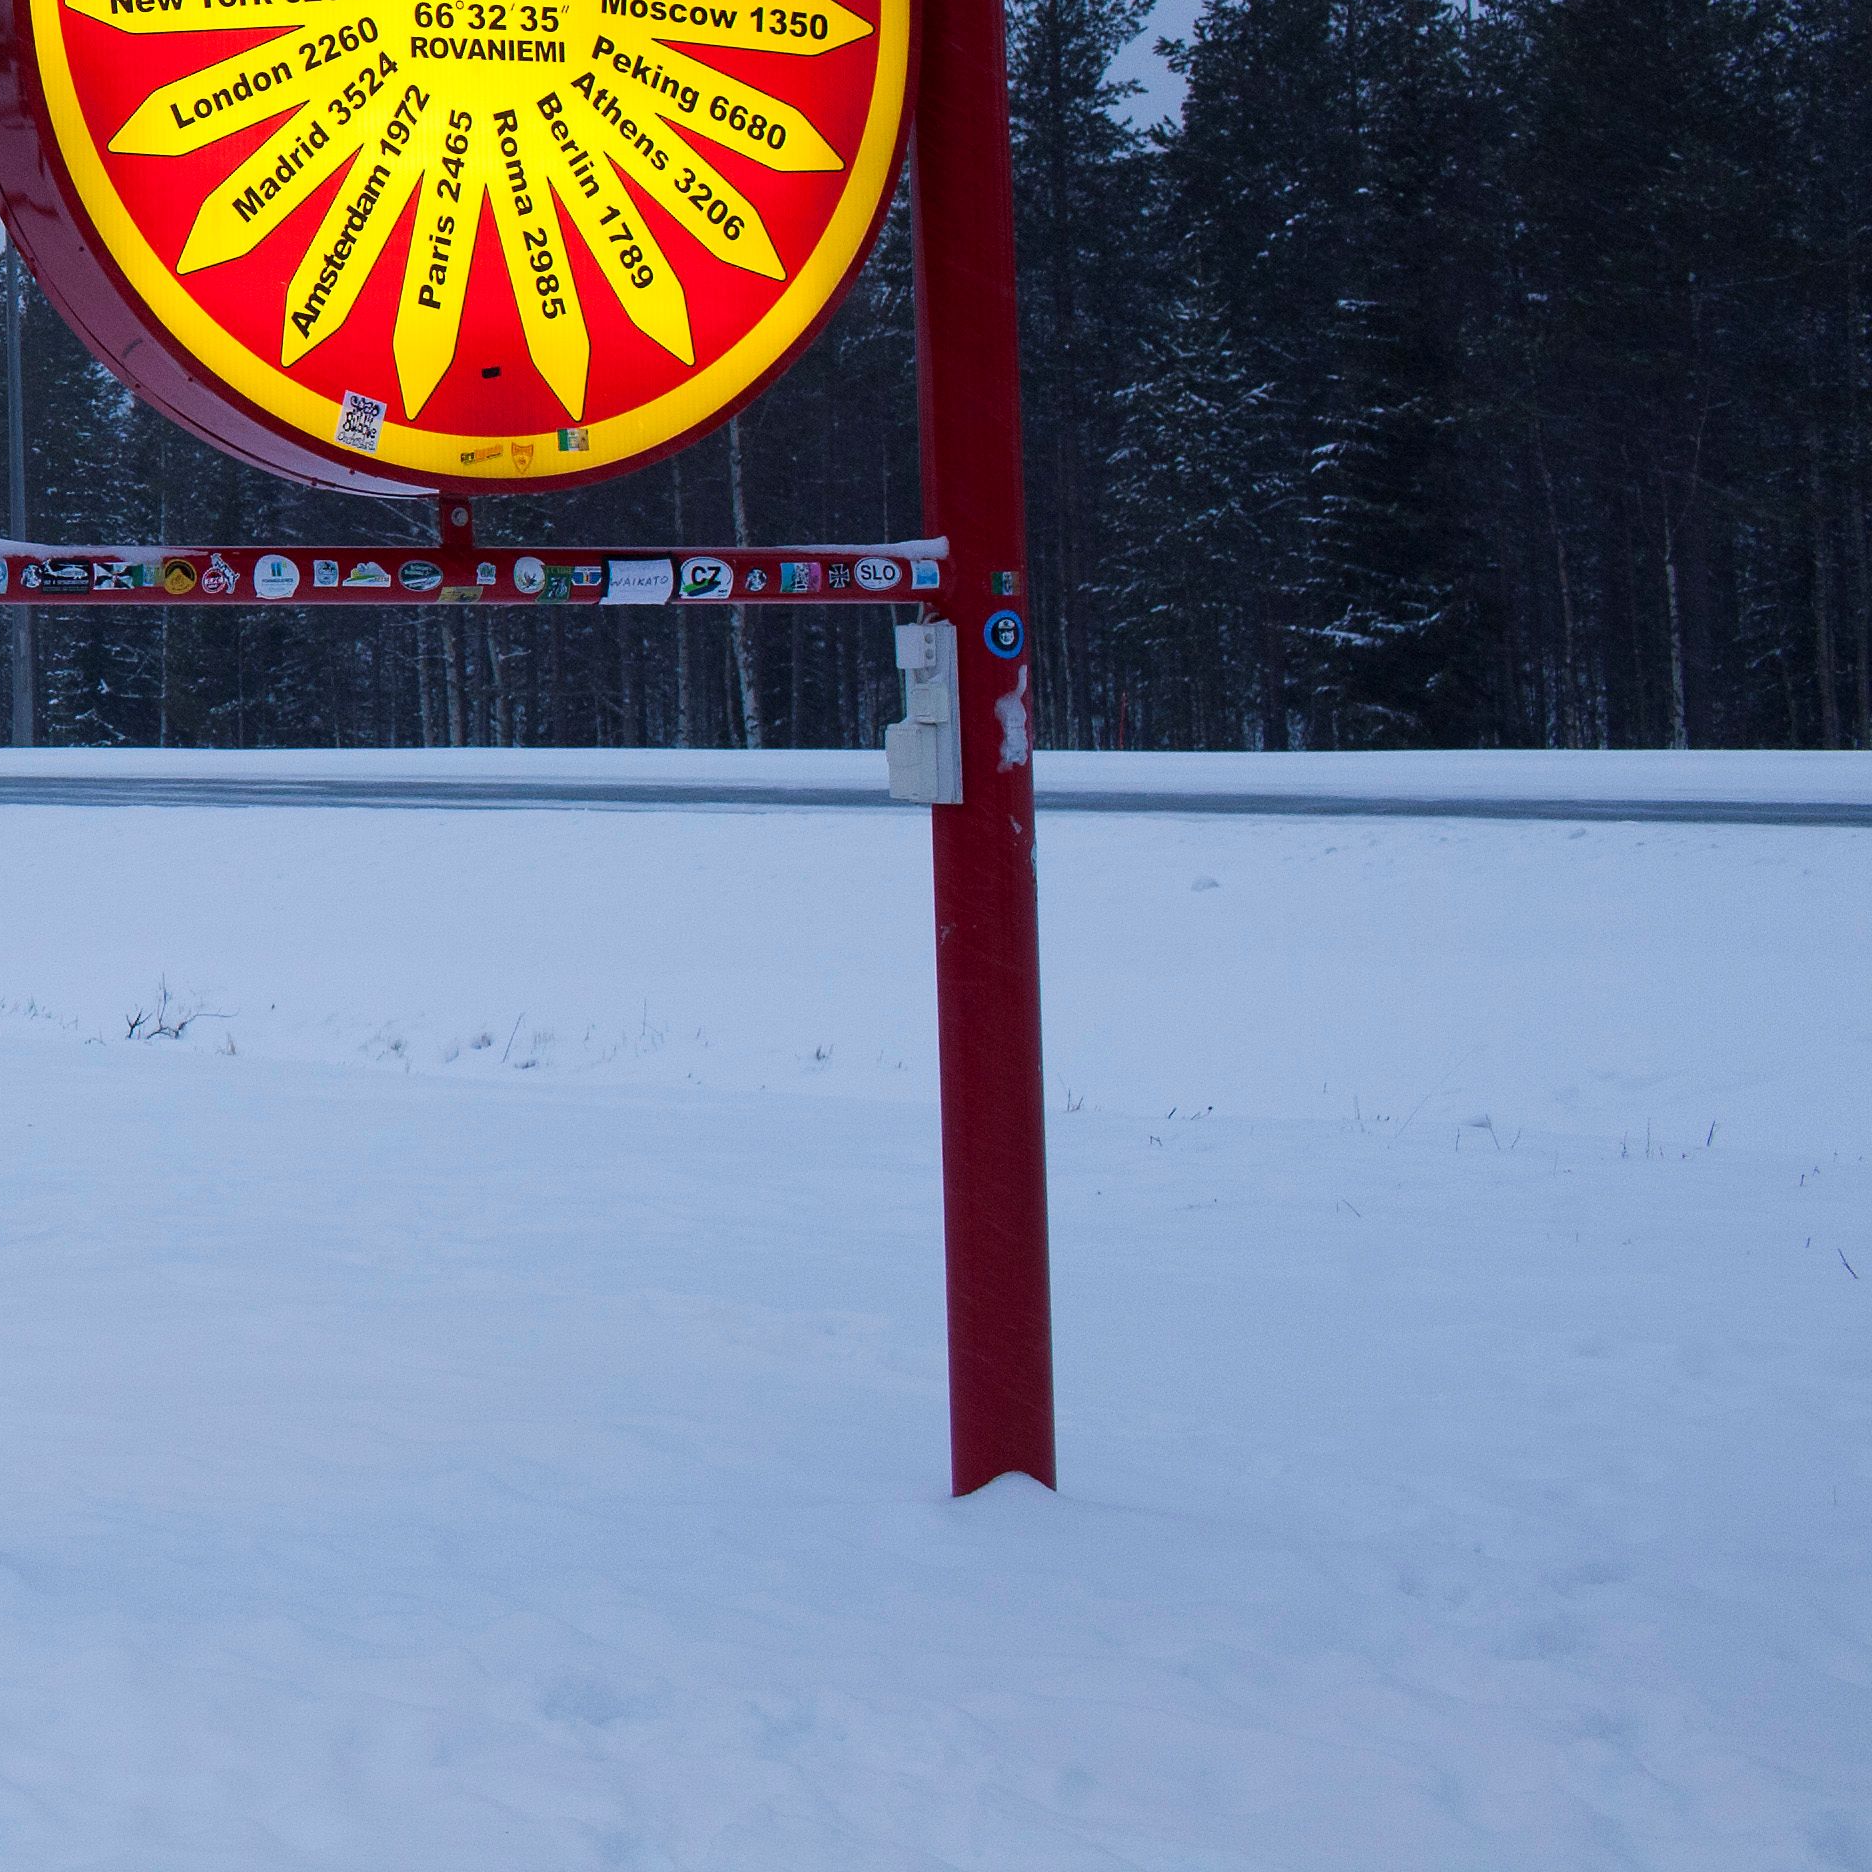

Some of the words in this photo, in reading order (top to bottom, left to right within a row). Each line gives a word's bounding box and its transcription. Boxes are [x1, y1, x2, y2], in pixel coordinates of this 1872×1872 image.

[171, 63, 292, 128] London
[299, 17, 378, 71] 2260
[412, 37, 564, 62] ROVANIEMI
[751, 7, 827, 40] 1350
[232, 122, 329, 222] Madrid
[329, 52, 398, 125] 3524
[592, 36, 699, 112] Peking
[710, 96, 786, 149] 6680
[294, 165, 390, 339] Amsterdam
[382, 85, 430, 156] 1972
[419, 216, 454, 309] Paris
[438, 110, 472, 202] 2465
[537, 92, 599, 197] Berlin
[600, 206, 653, 288] 1789
[571, 73, 668, 170] Athens
[675, 168, 744, 240] 3206
[494, 109, 532, 216] Roma
[523, 228, 566, 319] 2985
[610, 576, 669, 587] WAIKATO
[691, 565, 721, 585] CZ
[860, 565, 896, 581] SLO
